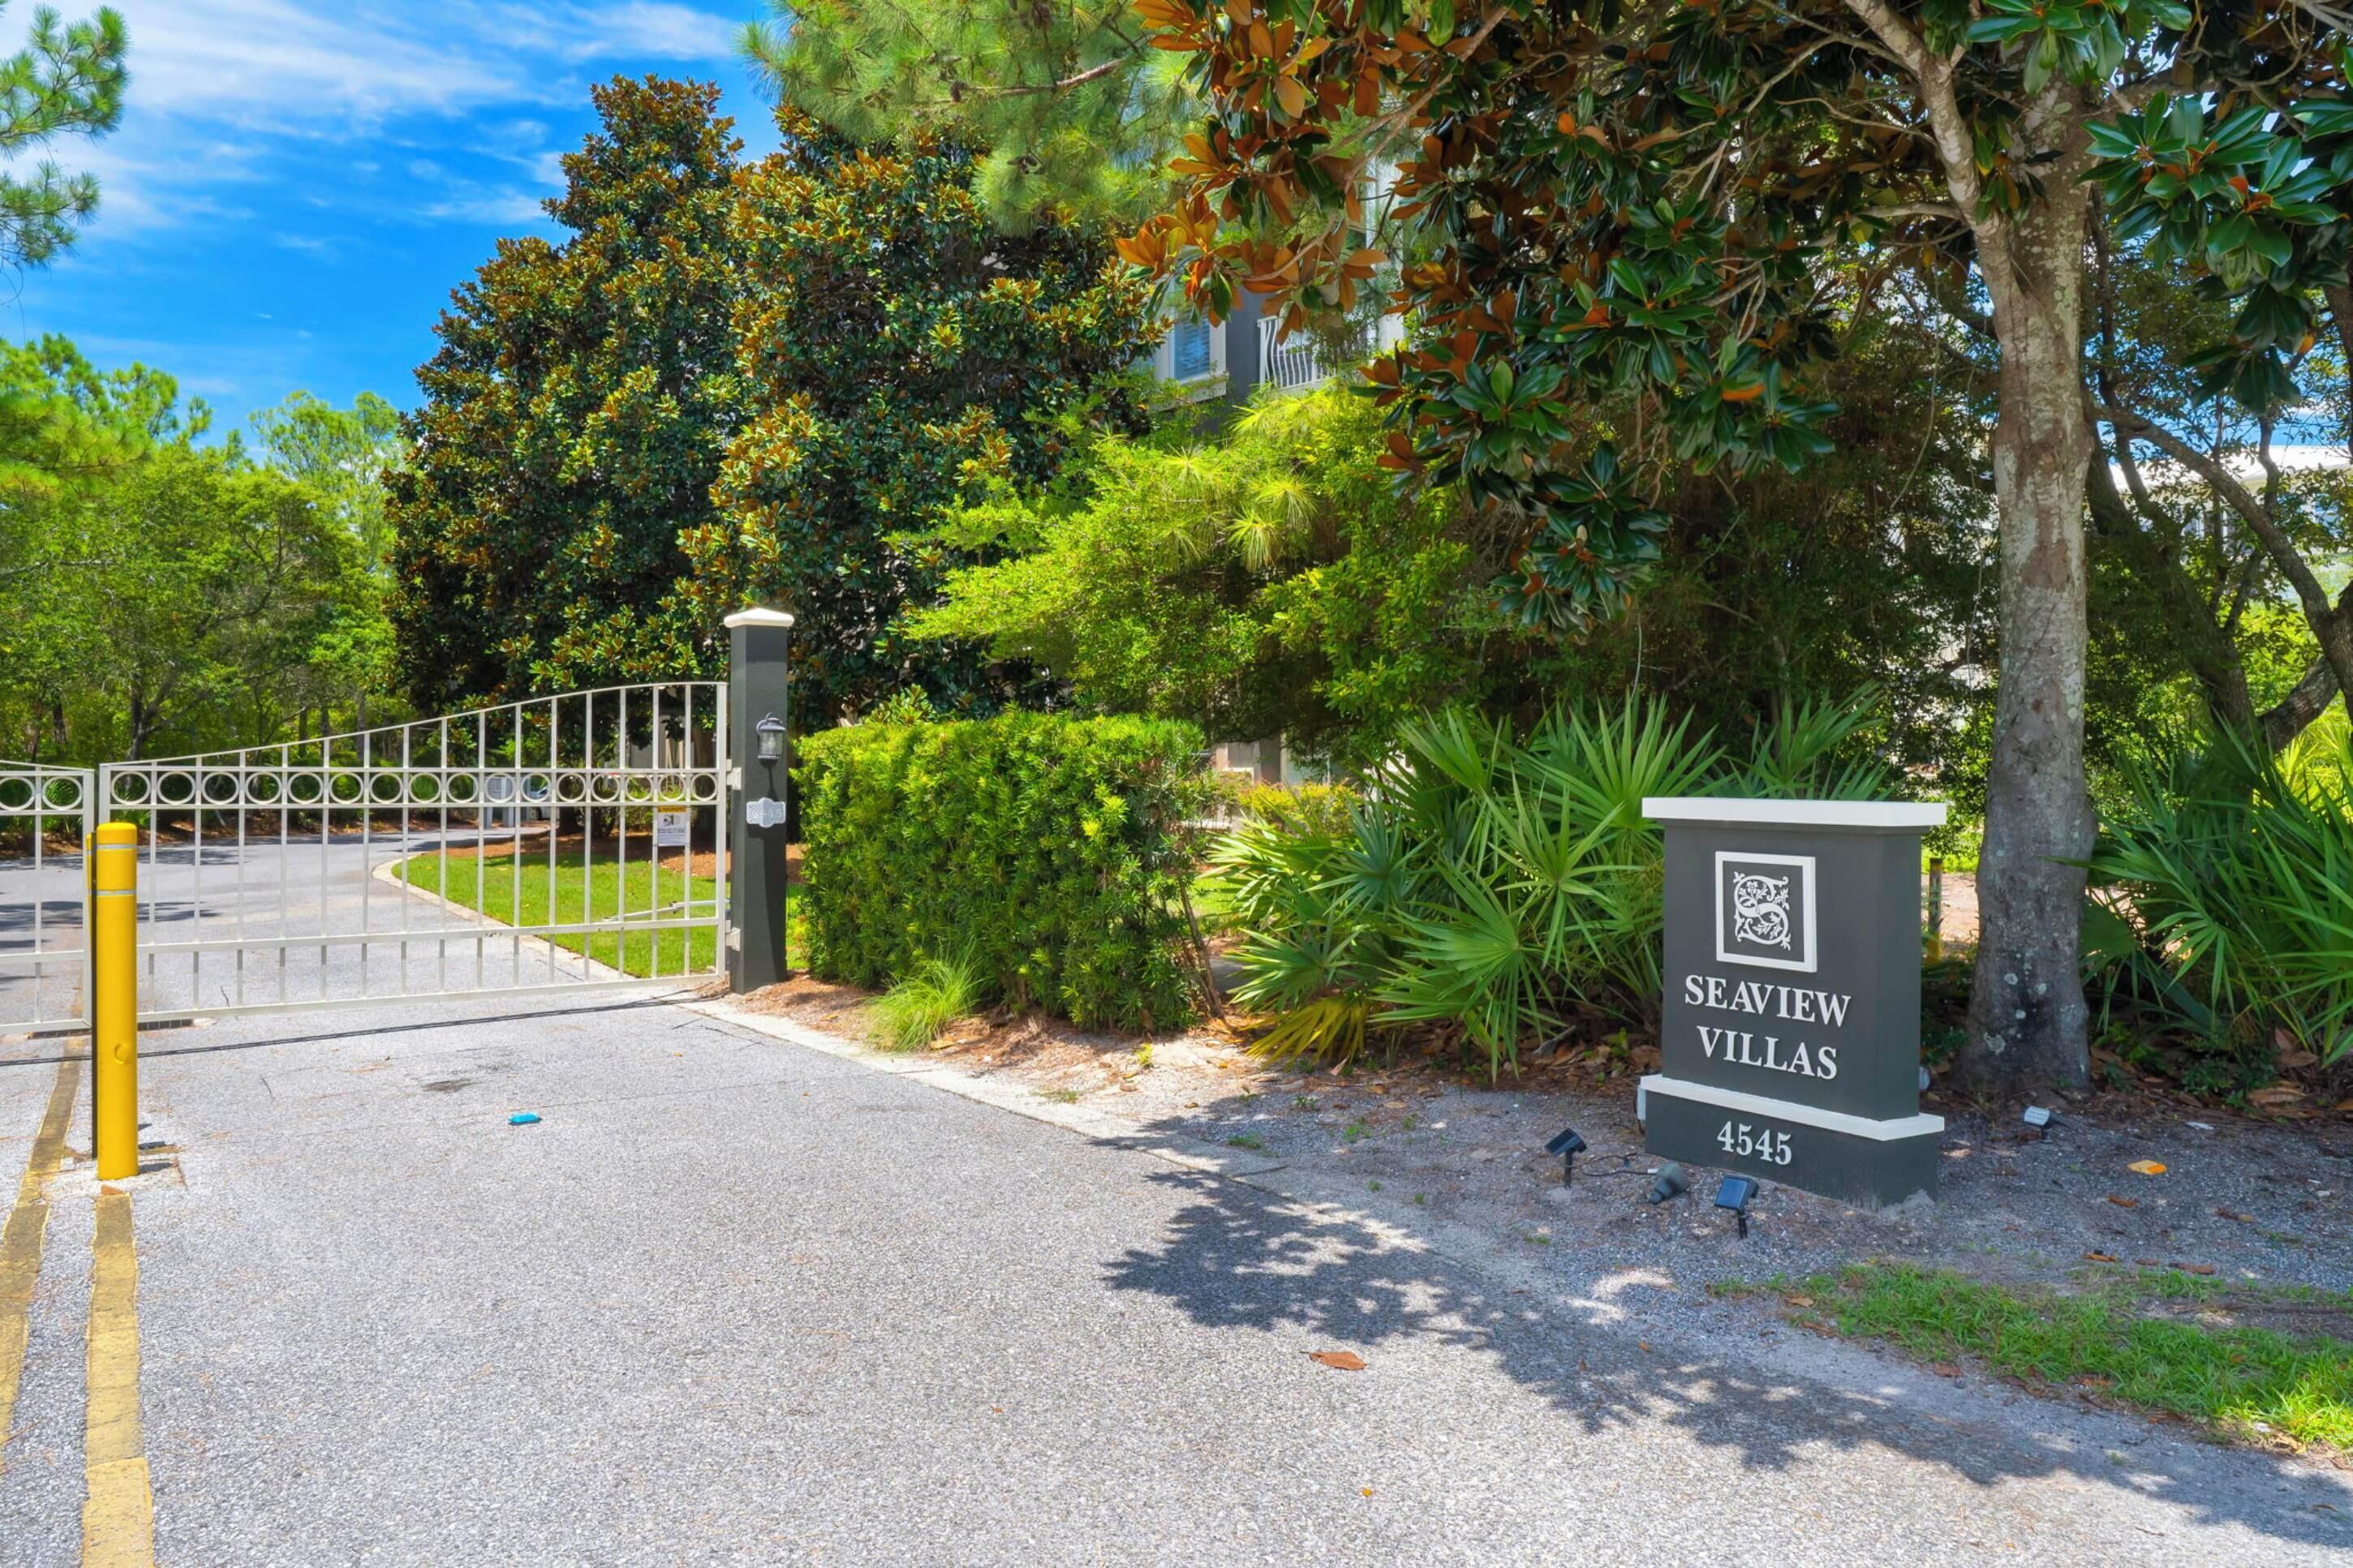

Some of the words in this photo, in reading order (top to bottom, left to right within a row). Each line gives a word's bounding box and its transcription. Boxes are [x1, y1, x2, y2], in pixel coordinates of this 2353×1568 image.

[1684, 974, 1852, 1027] SEAVIEW
[1697, 1025, 1838, 1080] VILLAS
[1717, 1121, 1792, 1166] 4545
